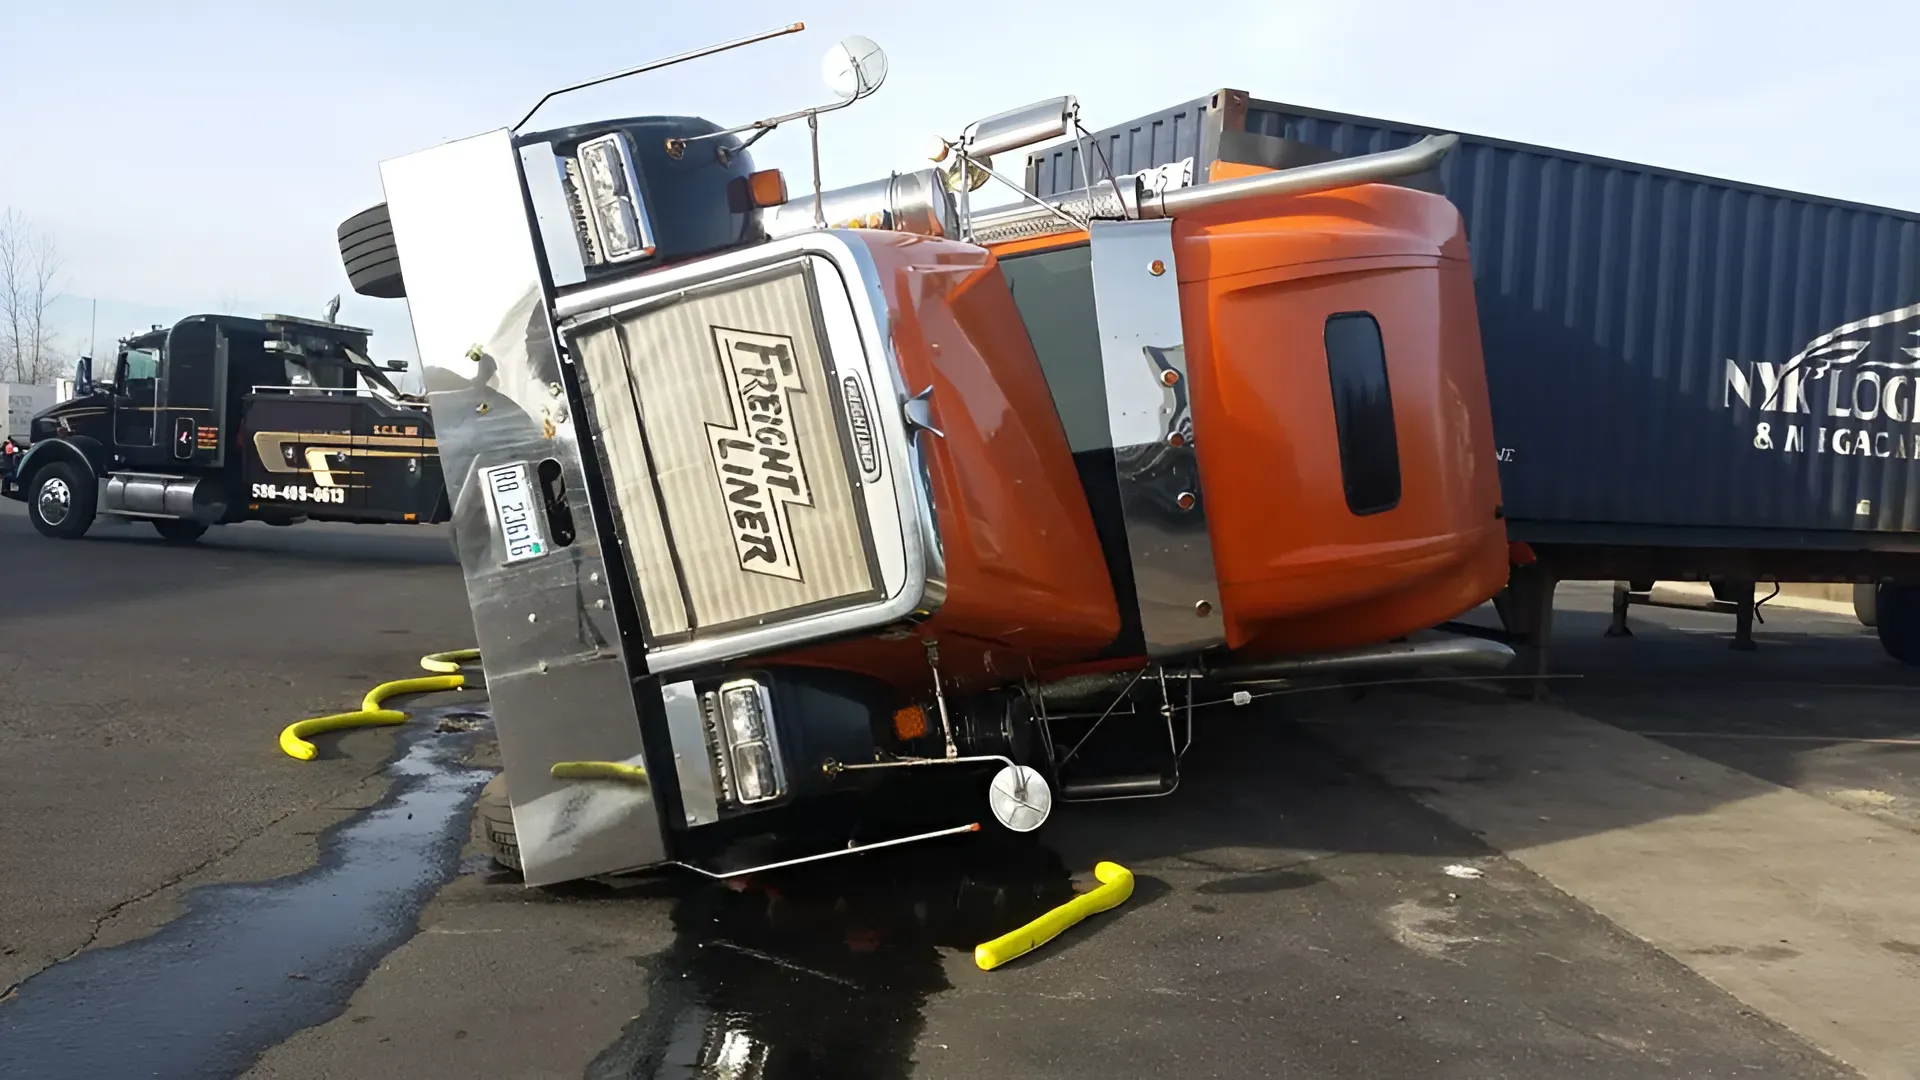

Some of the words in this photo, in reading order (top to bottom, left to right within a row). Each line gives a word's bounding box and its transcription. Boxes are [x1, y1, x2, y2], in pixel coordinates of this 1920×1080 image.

[734, 341, 800, 495] FREIGHT
[1724, 357, 1810, 414] NYK
[1753, 422, 1774, 450] &
[717, 438, 777, 564] LINER
